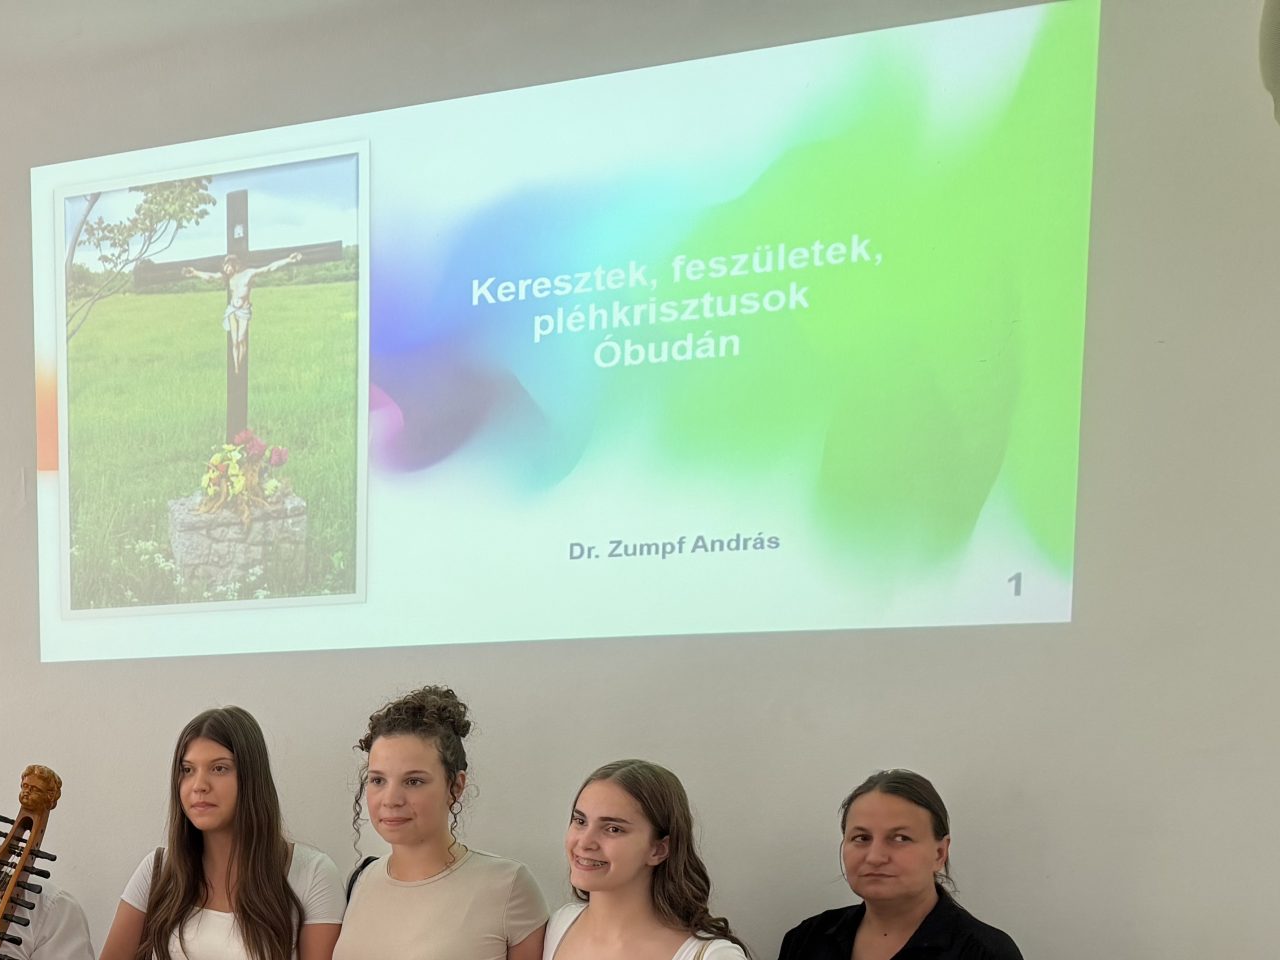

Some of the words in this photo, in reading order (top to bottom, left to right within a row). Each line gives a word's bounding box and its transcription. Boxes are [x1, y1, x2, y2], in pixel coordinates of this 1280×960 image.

[472, 260, 658, 306] Keresztek,
[671, 233, 883, 284] feszületek,
[533, 281, 810, 344] pléhkrisztusok
[593, 330, 741, 368] Óbudán
[569, 542, 600, 560] Dr.
[607, 536, 687, 560] Zumpf
[691, 532, 781, 554] András
[1007, 571, 1022, 597] 1
